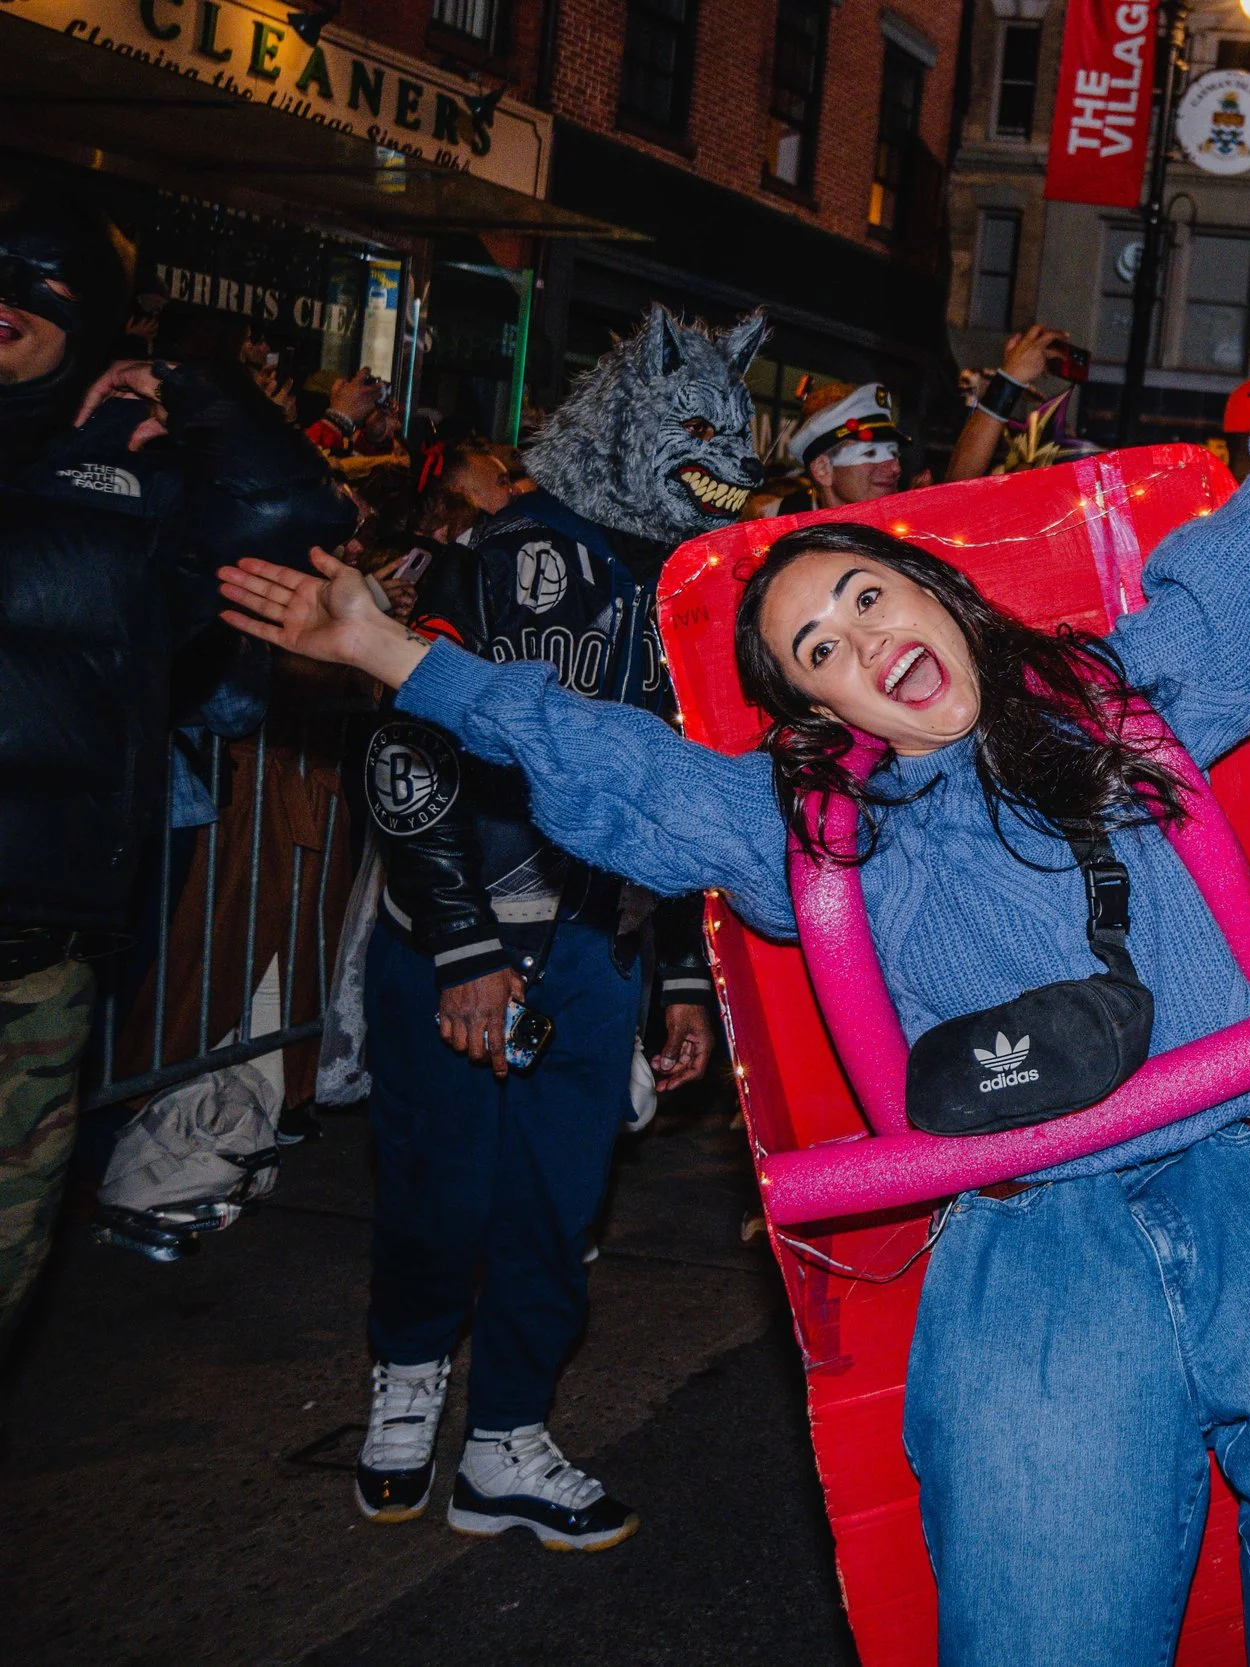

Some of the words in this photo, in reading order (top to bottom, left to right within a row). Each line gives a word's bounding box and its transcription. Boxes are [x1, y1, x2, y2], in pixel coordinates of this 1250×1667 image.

[1100, 0, 1150, 158] VILLAG
[1067, 69, 1112, 156] THE
[56, 469, 114, 483] NORTH
[81, 463, 115, 474] THE
[73, 479, 114, 494] FACE
[407, 792, 449, 829] YORK
[979, 1068, 1040, 1093] adidas
